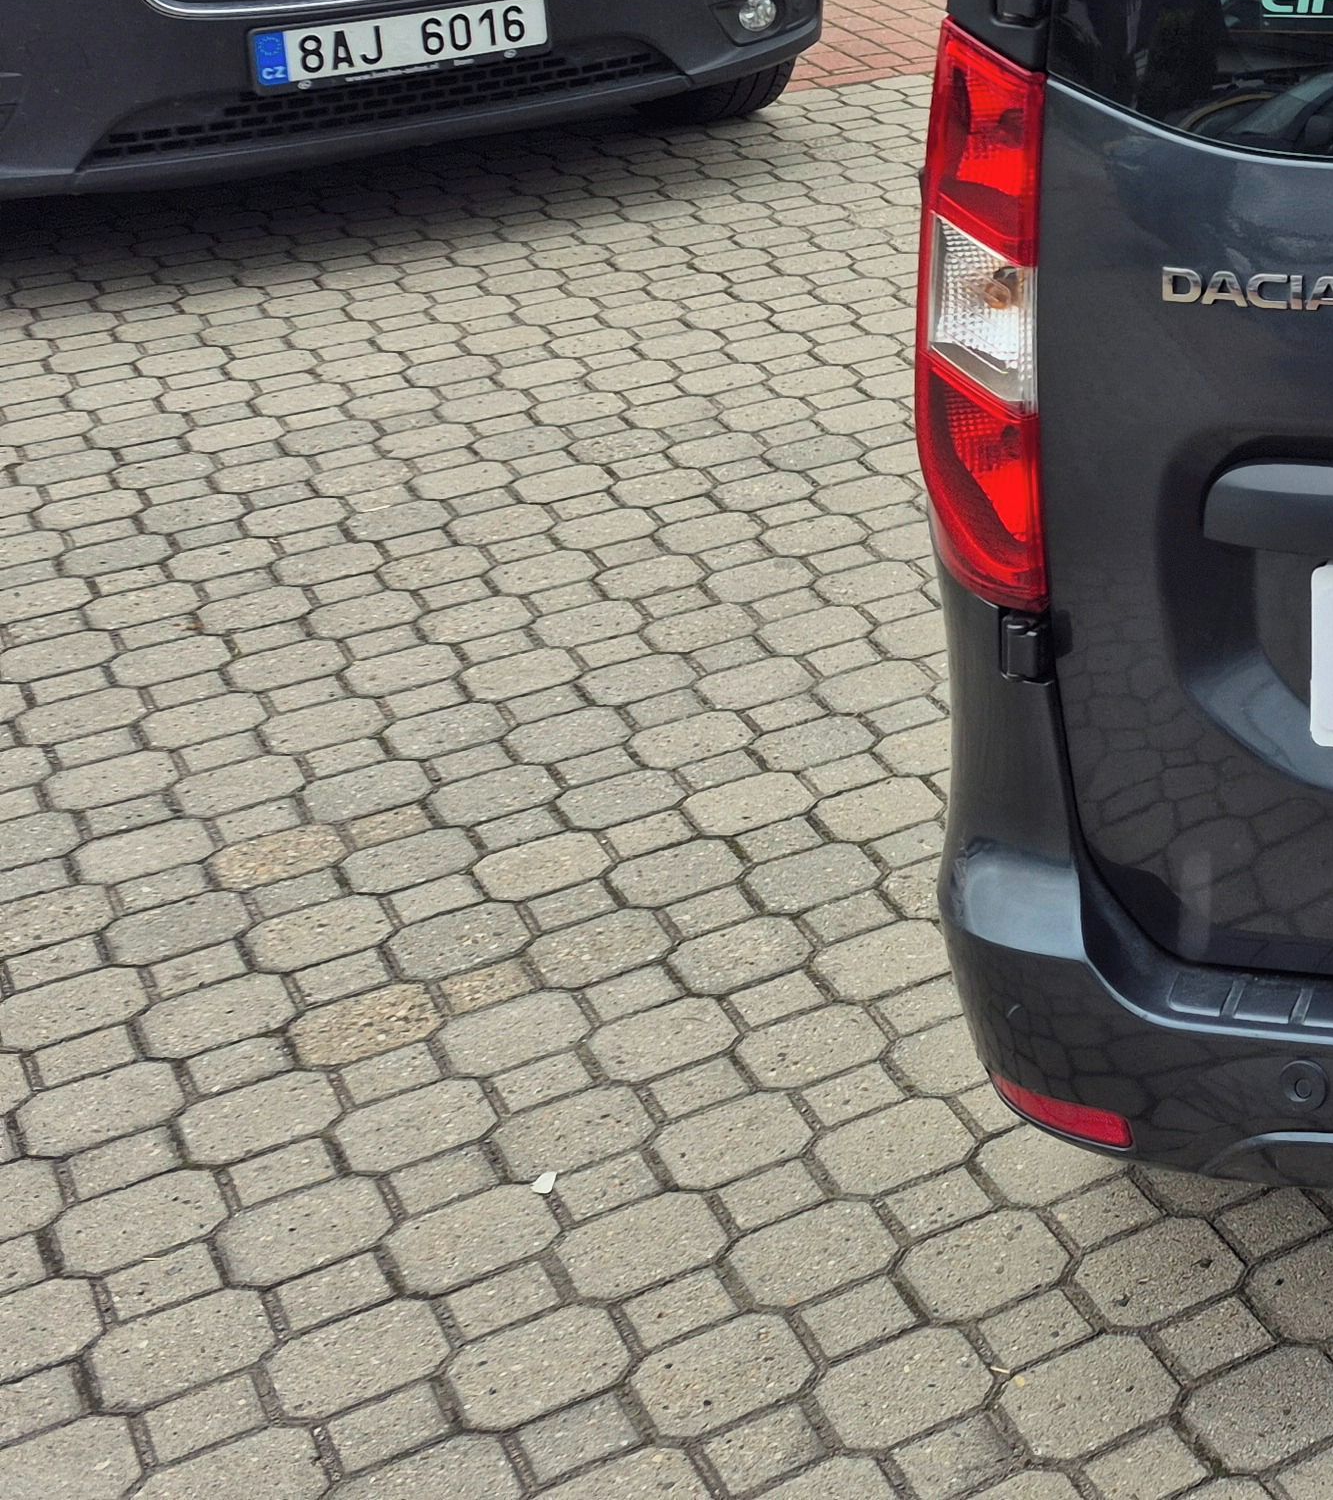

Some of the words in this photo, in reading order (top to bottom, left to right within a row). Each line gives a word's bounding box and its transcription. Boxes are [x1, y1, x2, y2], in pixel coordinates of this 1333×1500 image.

[298, 25, 384, 74] 8AJ
[421, 5, 526, 55] 6016
[262, 66, 287, 80] CZ
